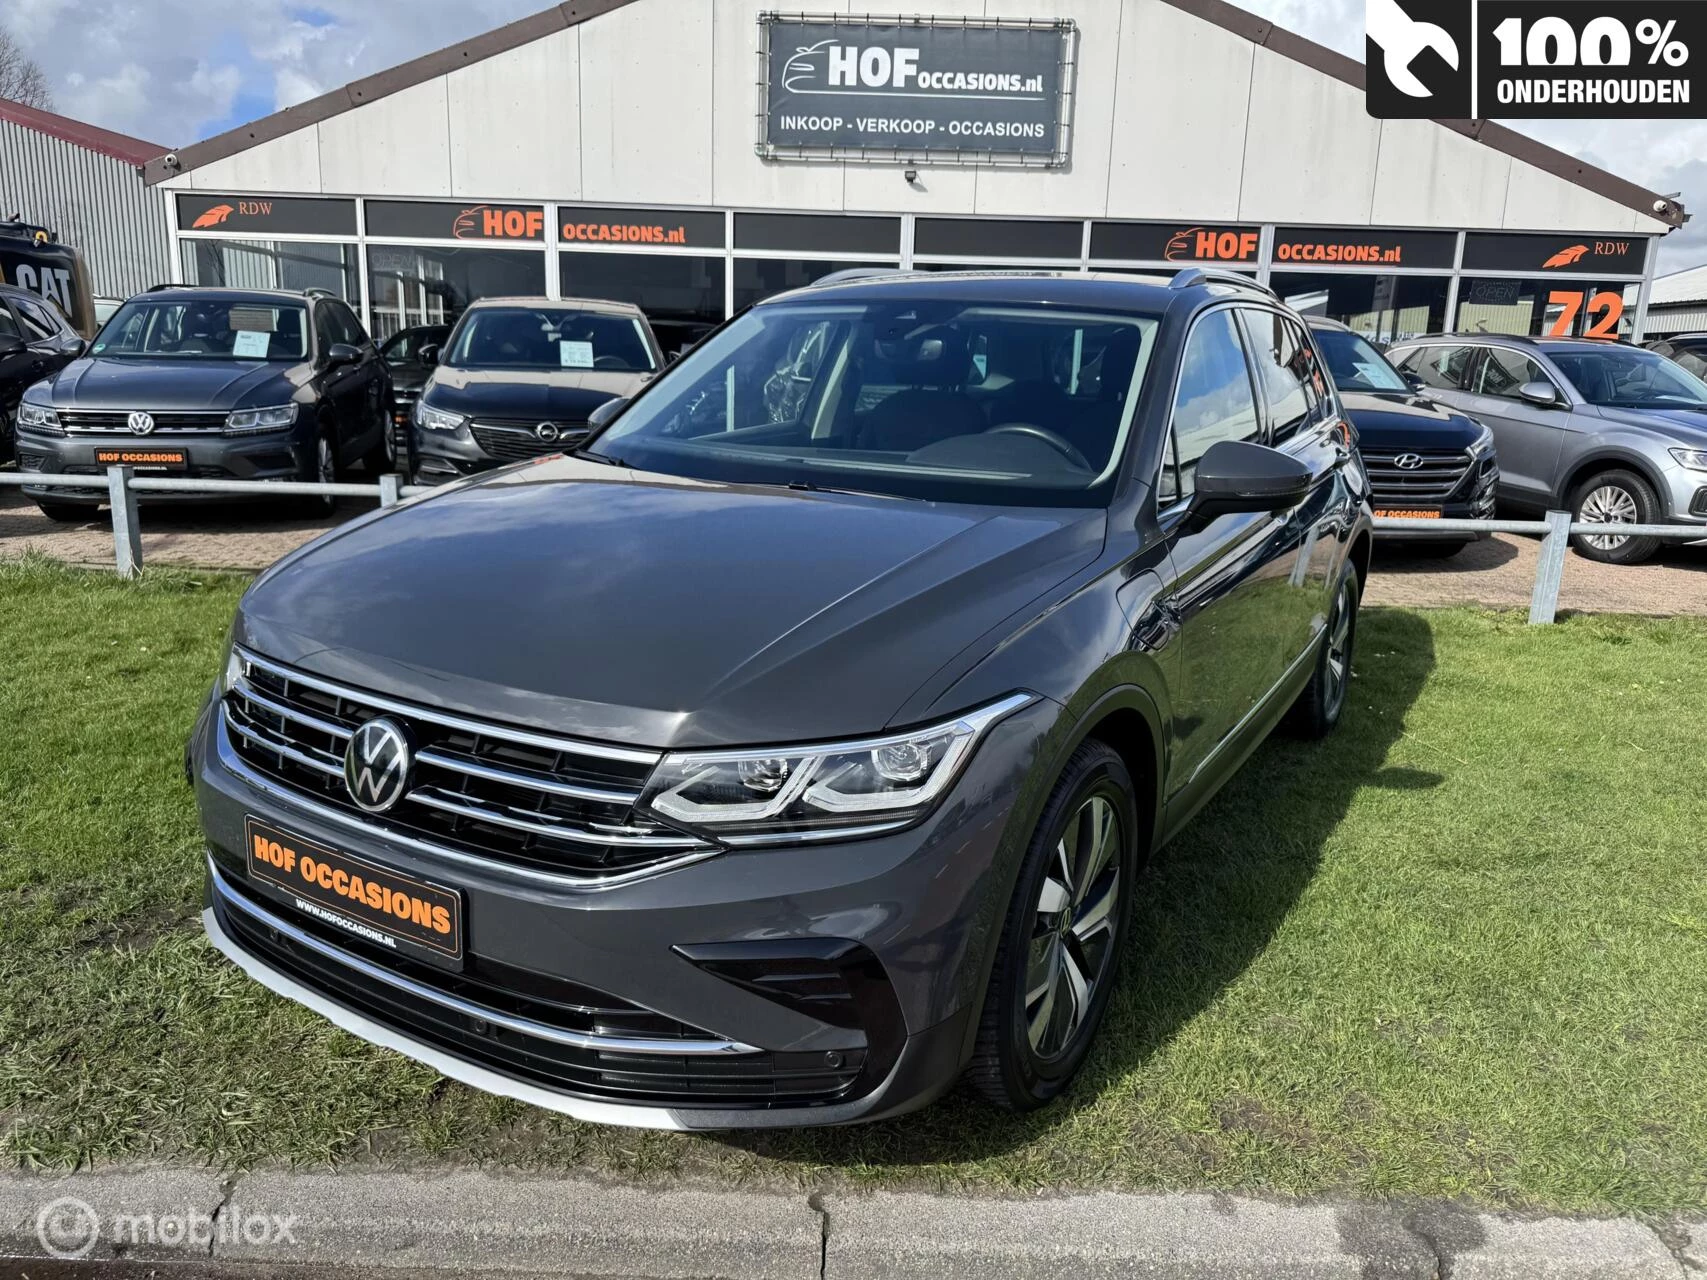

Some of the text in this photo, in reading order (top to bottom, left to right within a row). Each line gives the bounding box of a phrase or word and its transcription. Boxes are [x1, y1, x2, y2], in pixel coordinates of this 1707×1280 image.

[828, 46, 1043, 93] HOF OCCASIONS.nl
[780, 115, 843, 131] INKOOP
[856, 118, 935, 134] VERKOOP
[949, 122, 1045, 137] OCCASIONS
[239, 201, 272, 215] RDW
[483, 209, 686, 243] HOF OCCASIONS.nl
[1195, 231, 1401, 263] HOF OCCASIONS.nl
[1594, 241, 1630, 256] RDW
[15, 264, 73, 318] CAT
[1548, 290, 1624, 340] 72
[98, 452, 183, 462] HOF OCCASIONS
[1387, 510, 1440, 519] OCCASIONS
[253, 834, 451, 934] HOF OCCASIONS
[295, 898, 397, 948] WWW.HOFOCCASIONS.NL
